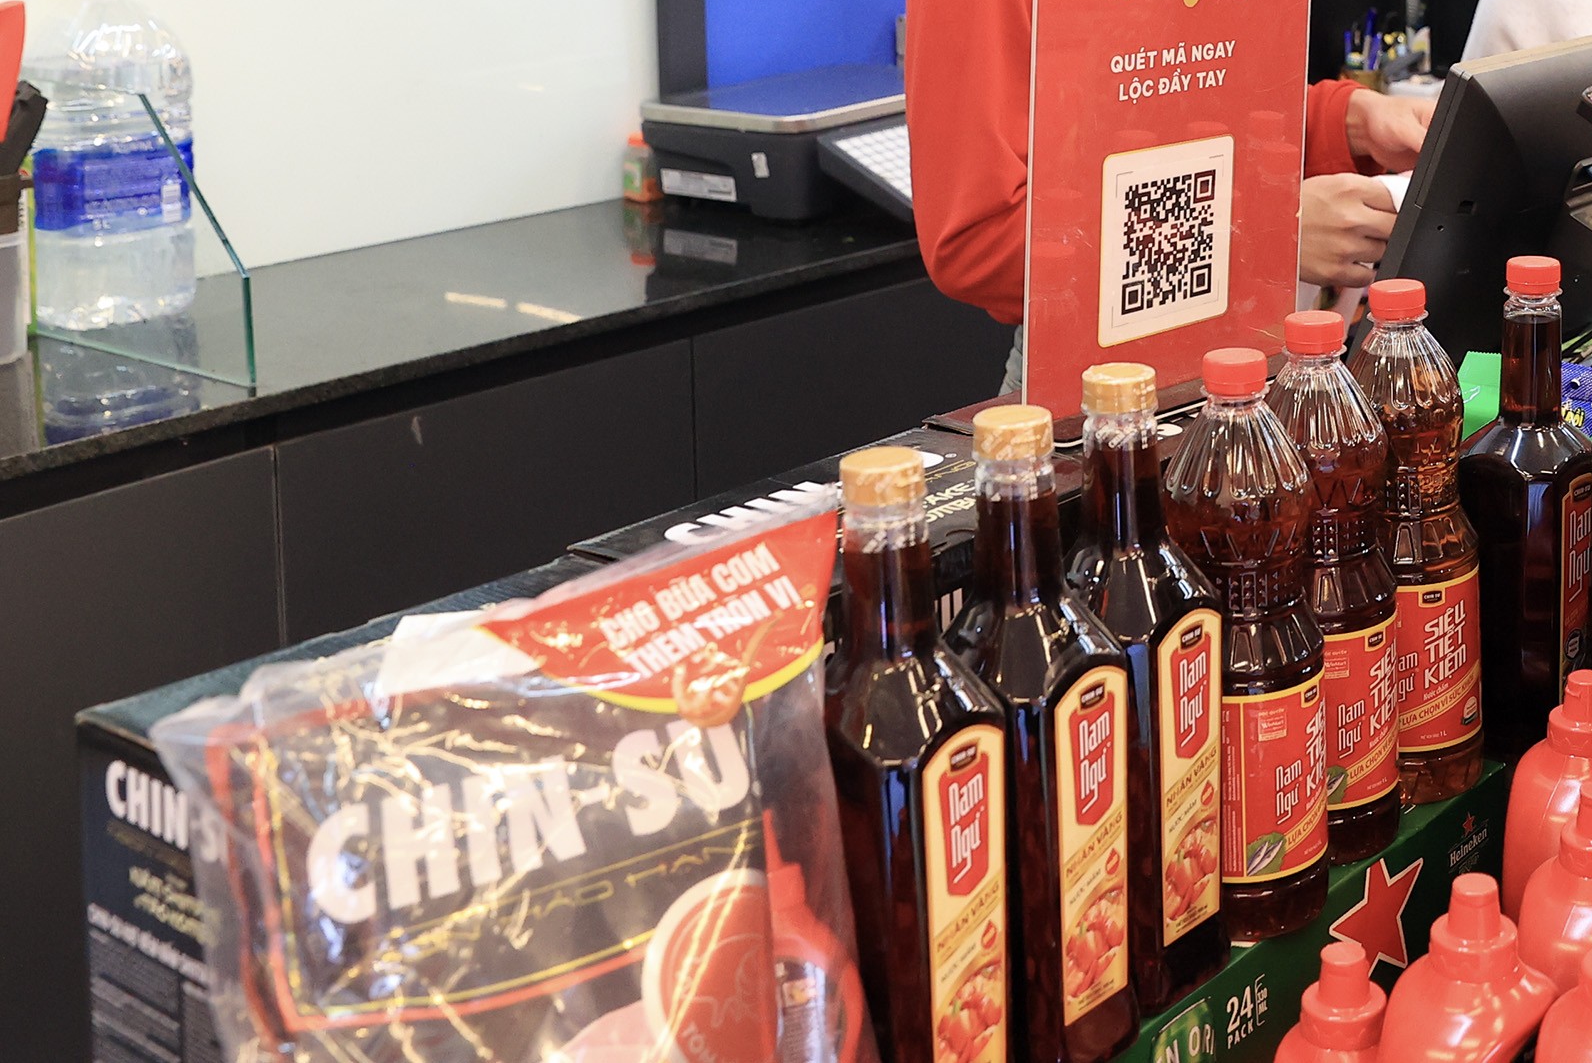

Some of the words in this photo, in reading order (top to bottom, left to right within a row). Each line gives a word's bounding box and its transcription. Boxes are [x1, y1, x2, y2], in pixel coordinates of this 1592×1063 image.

[1110, 47, 1157, 73] QUÉT
[1162, 42, 1186, 66] MÃ
[1191, 40, 1236, 62] NGAY
[1119, 77, 1153, 104] LỘC
[1158, 68, 1191, 95] ĐẦY
[1196, 69, 1226, 89] TAY
[600, 600, 660, 649] CHO
[1424, 600, 1466, 643] SIÊU
[1425, 621, 1465, 663] TIẾT
[1178, 651, 1207, 697] Nam
[1398, 652, 1418, 672] am
[1424, 643, 1466, 689] KIỆM
[1398, 673, 1415, 702] gư
[1180, 684, 1204, 748] Ngư
[1305, 697, 1326, 748] SIÊ
[1337, 699, 1365, 728] Nam
[1402, 714, 1417, 726] LỰA
[1419, 704, 1440, 719] CHỌN
[1079, 710, 1111, 760] Nam
[1338, 722, 1362, 759] Ngư
[1080, 748, 1107, 815] Ngư
[1275, 759, 1302, 792] Nam
[948, 772, 984, 825] Nam
[1276, 783, 1299, 825] Ngư
[951, 809, 982, 884] Ngư
[1450, 829, 1487, 867] Heineken
[1227, 985, 1253, 1033] 24
[1228, 1018, 1253, 1049] PACK
